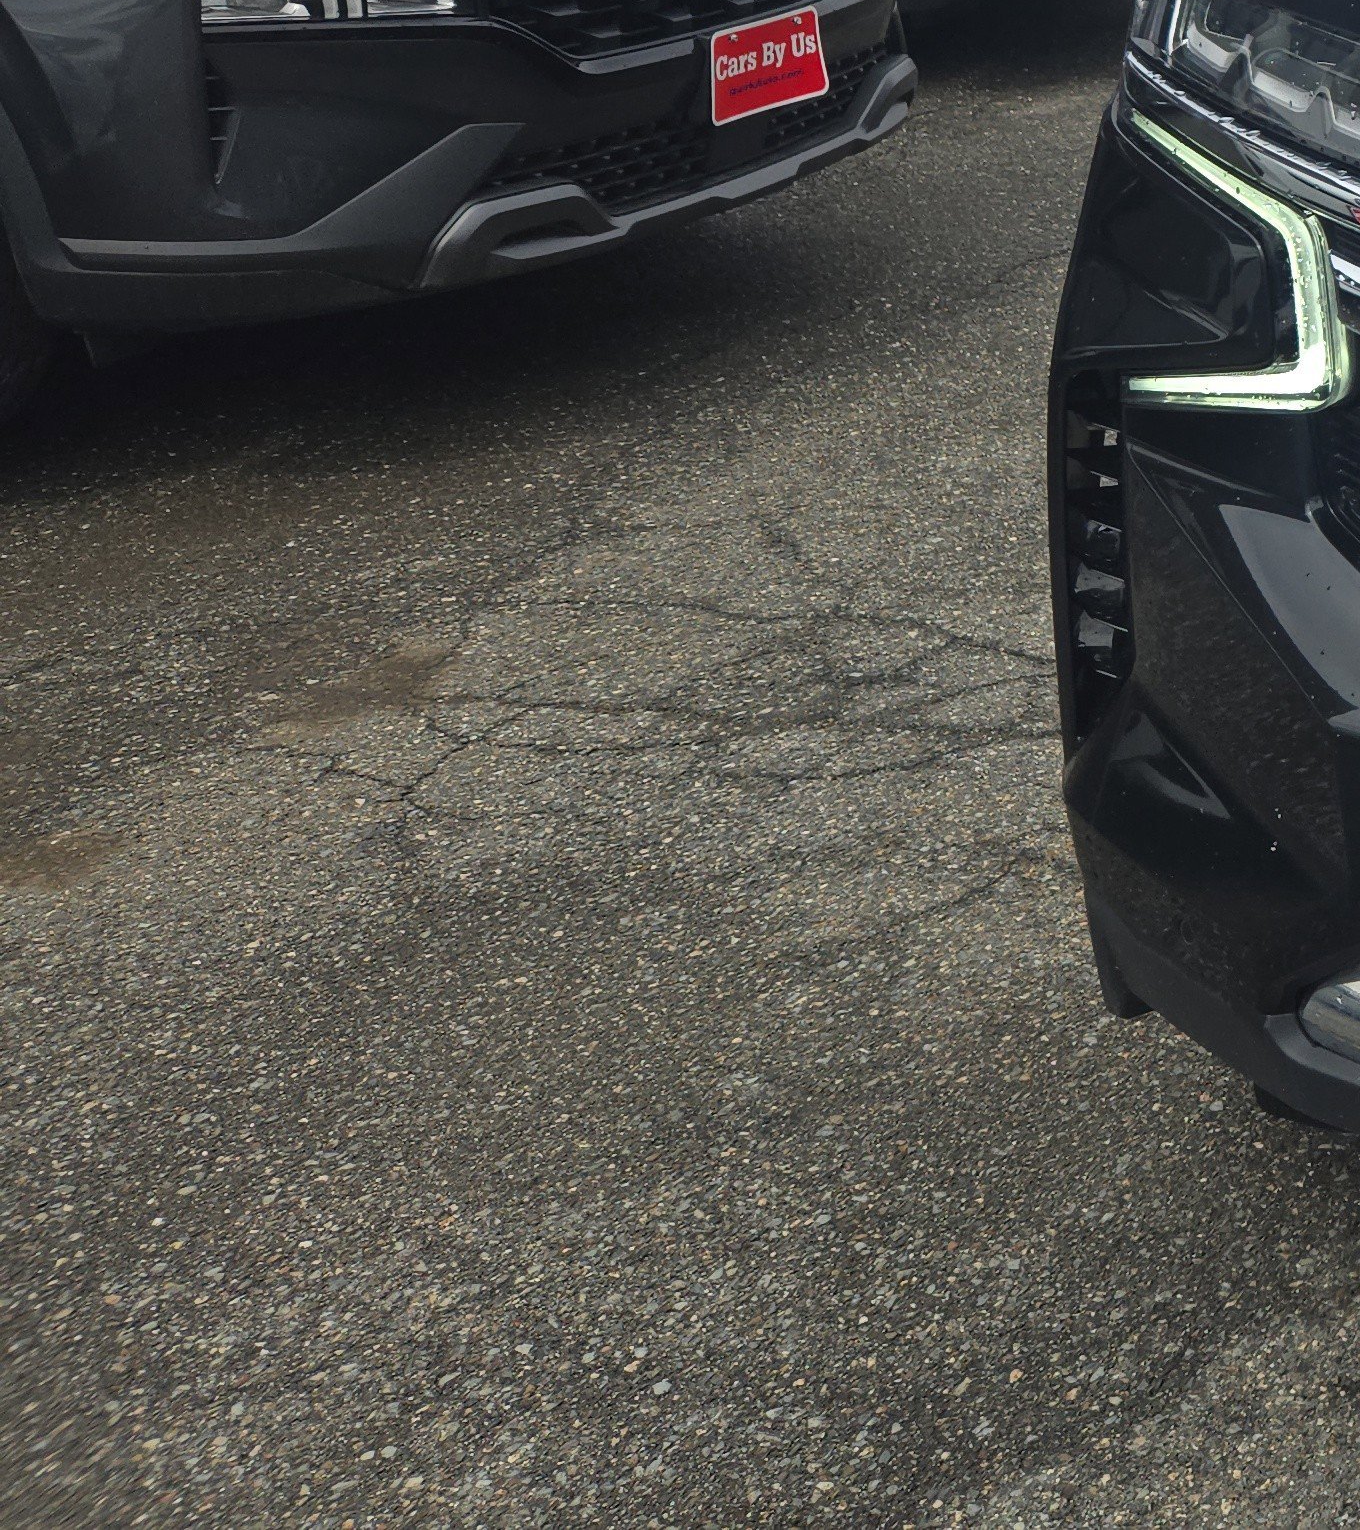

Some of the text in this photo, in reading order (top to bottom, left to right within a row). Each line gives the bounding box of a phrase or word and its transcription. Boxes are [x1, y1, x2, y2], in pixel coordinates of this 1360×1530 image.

[715, 31, 817, 81] Cars By Us
